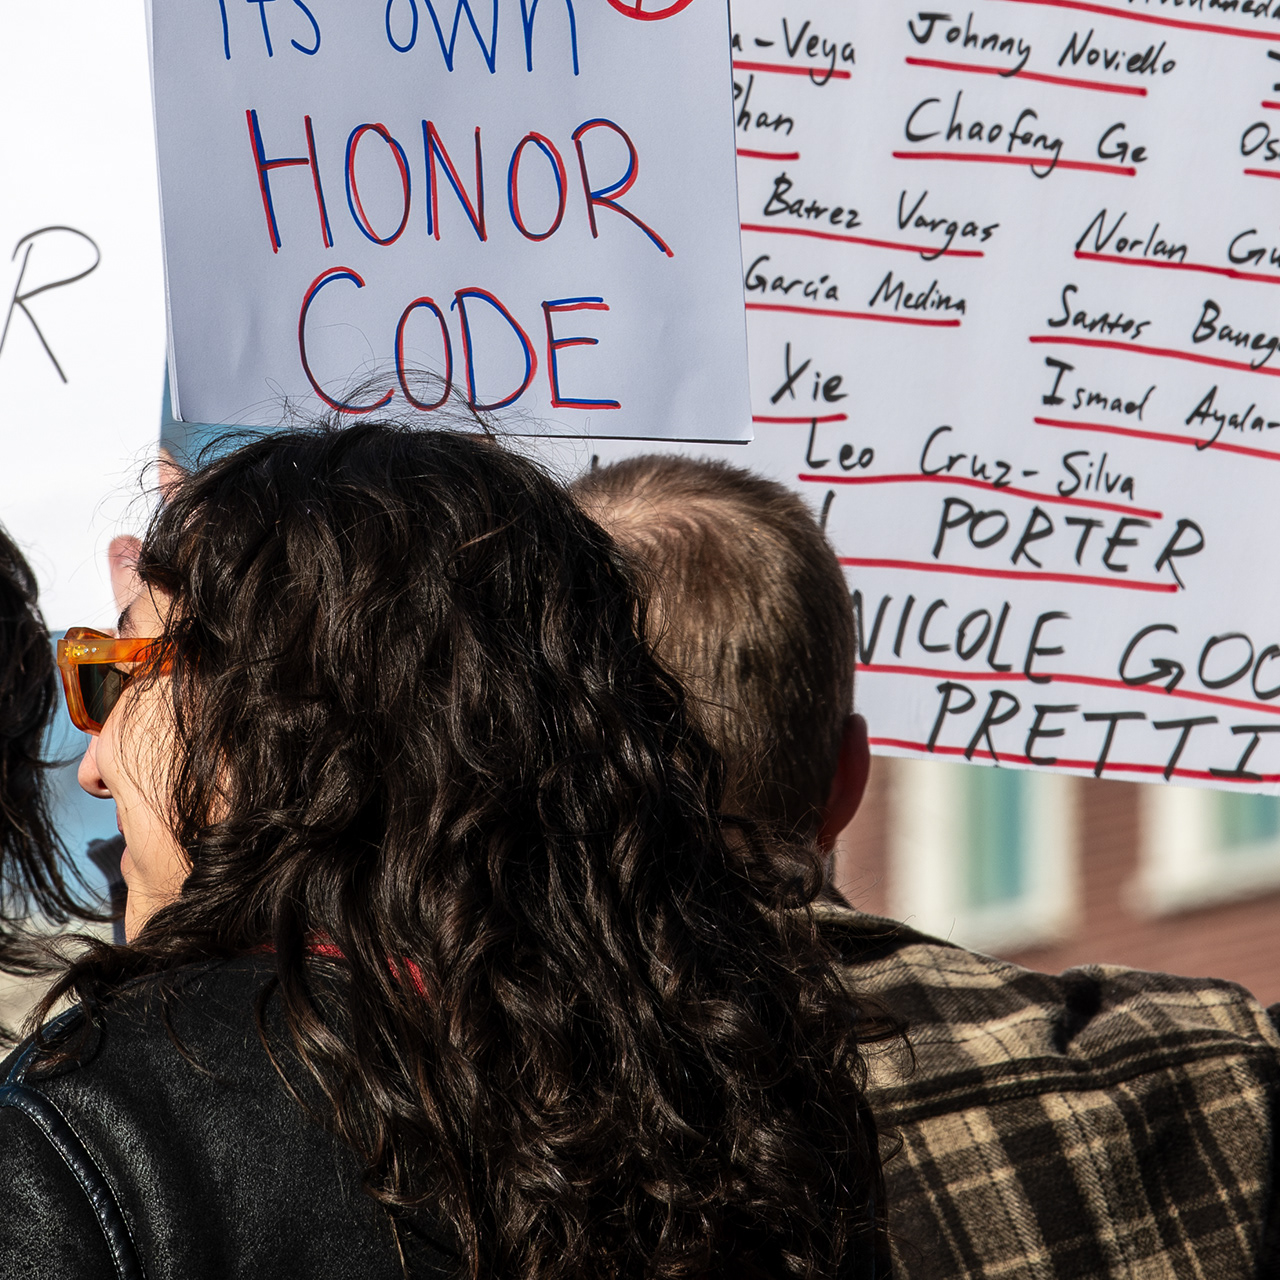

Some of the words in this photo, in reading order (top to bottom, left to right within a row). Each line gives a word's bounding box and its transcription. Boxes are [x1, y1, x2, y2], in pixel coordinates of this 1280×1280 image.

[908, 12, 1032, 78] Johnny
[1058, 28, 1177, 76] Noviello
[1097, 122, 1148, 164] Ge
[245, 109, 674, 258] HONOR
[763, 172, 861, 229] Batrez
[897, 190, 1000, 261] Vargas
[1075, 208, 1188, 263] Norlan
[868, 271, 967, 316] Medina
[1048, 284, 1151, 341] Santos
[298, 266, 621, 415] CODE
[771, 342, 849, 404] Xie
[805, 417, 874, 471] Leo
[932, 497, 1205, 591] PORTER
